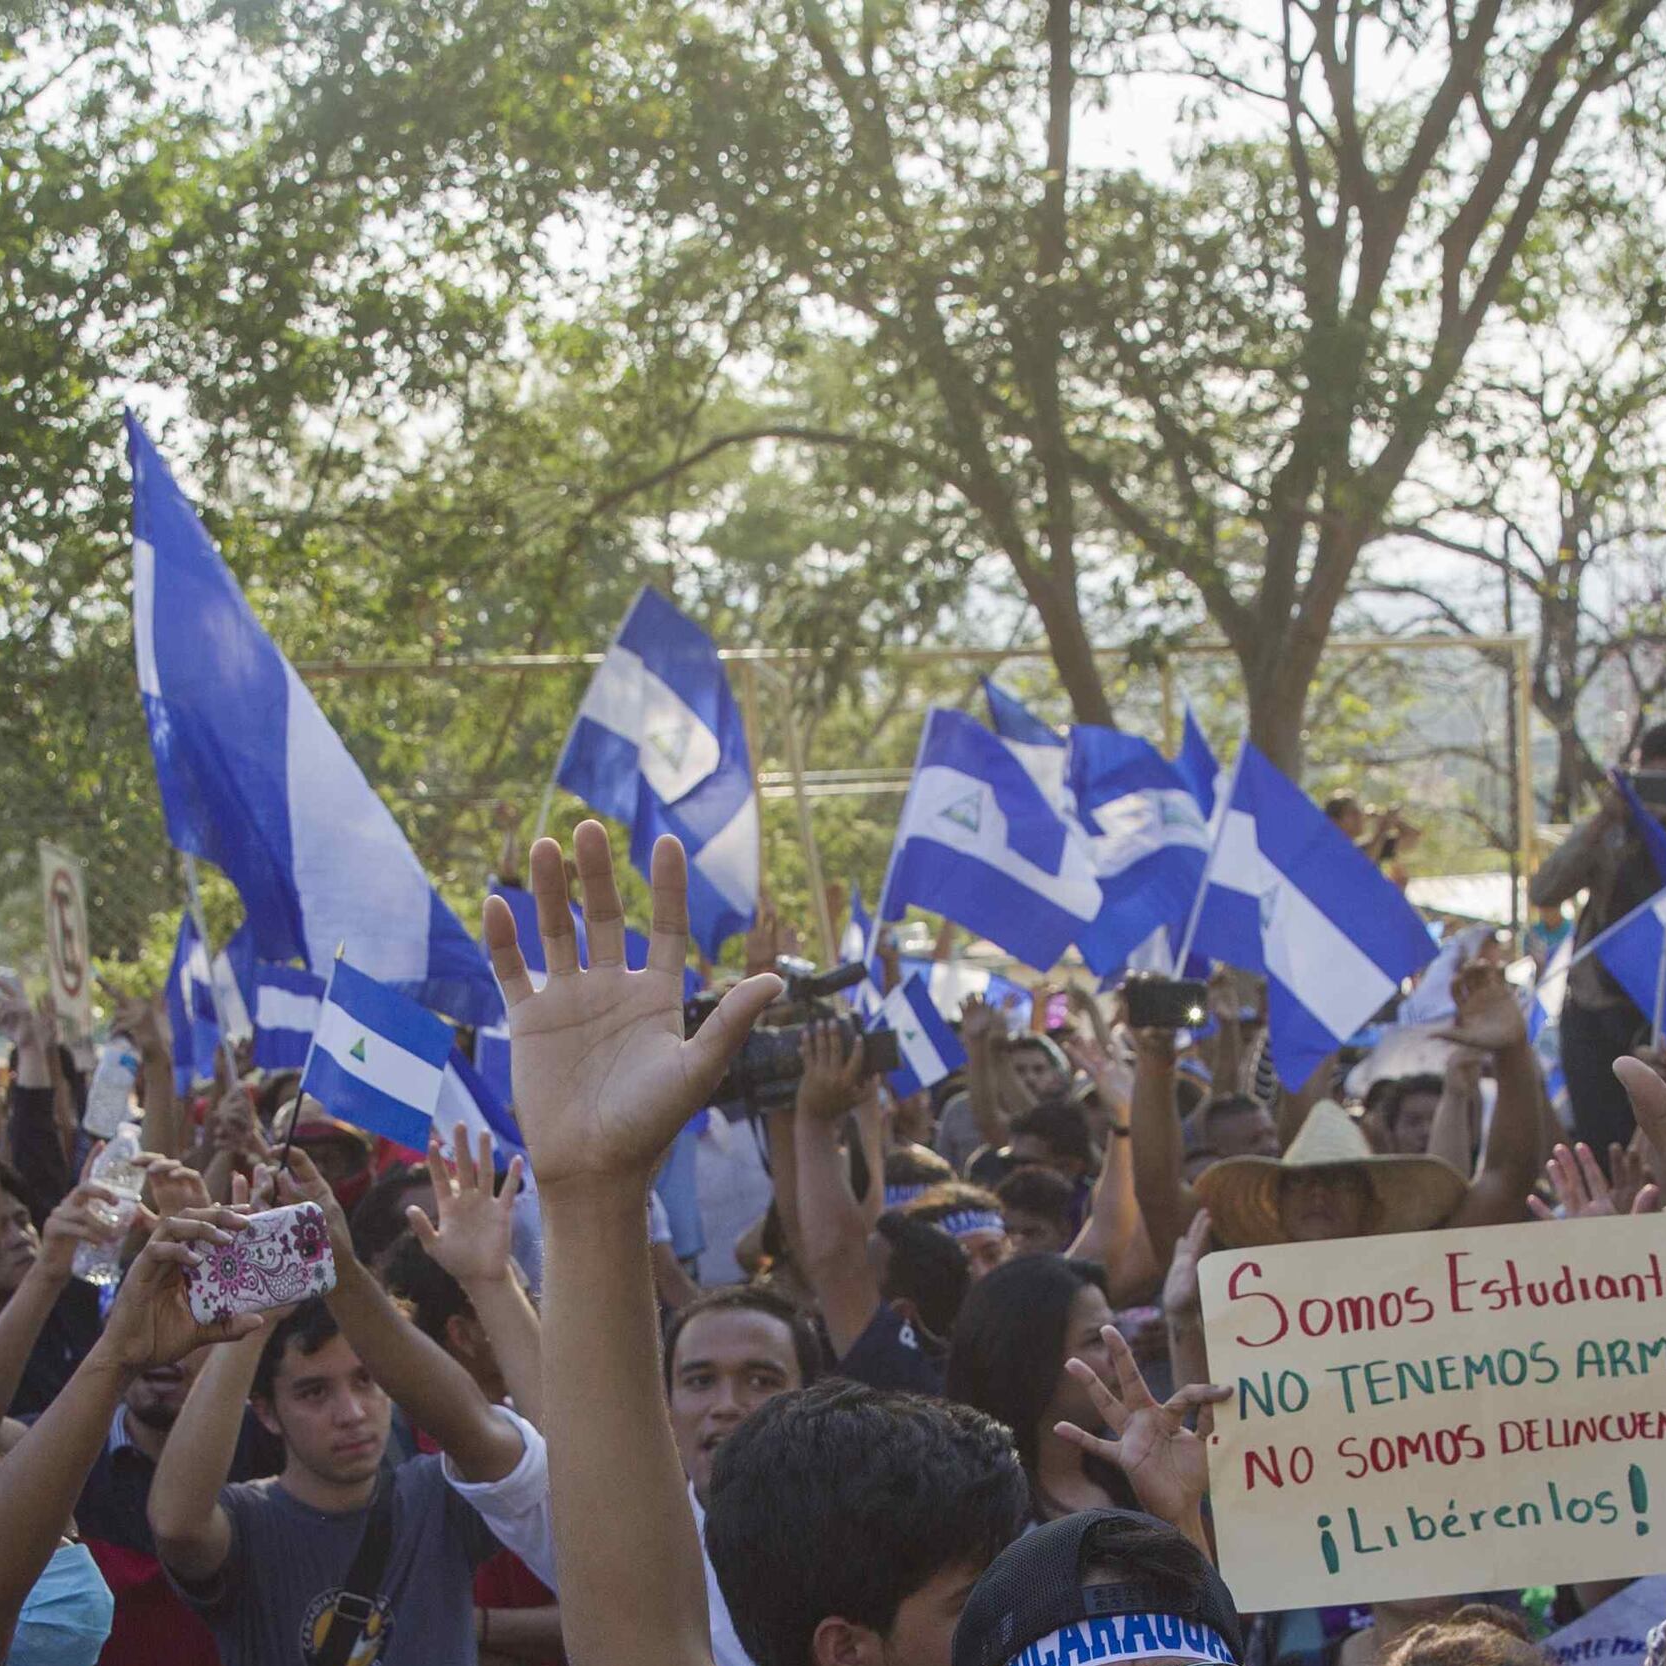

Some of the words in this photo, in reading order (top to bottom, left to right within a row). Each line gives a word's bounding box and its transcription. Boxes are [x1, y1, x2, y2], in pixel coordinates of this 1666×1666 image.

[1228, 1261, 1434, 1347] Somos
[1237, 1370, 1310, 1421] NO
[1325, 1340, 1560, 1414] TENEMOS
[1244, 1445, 1314, 1491] NO
[1337, 1423, 1485, 1480] SOMOS
